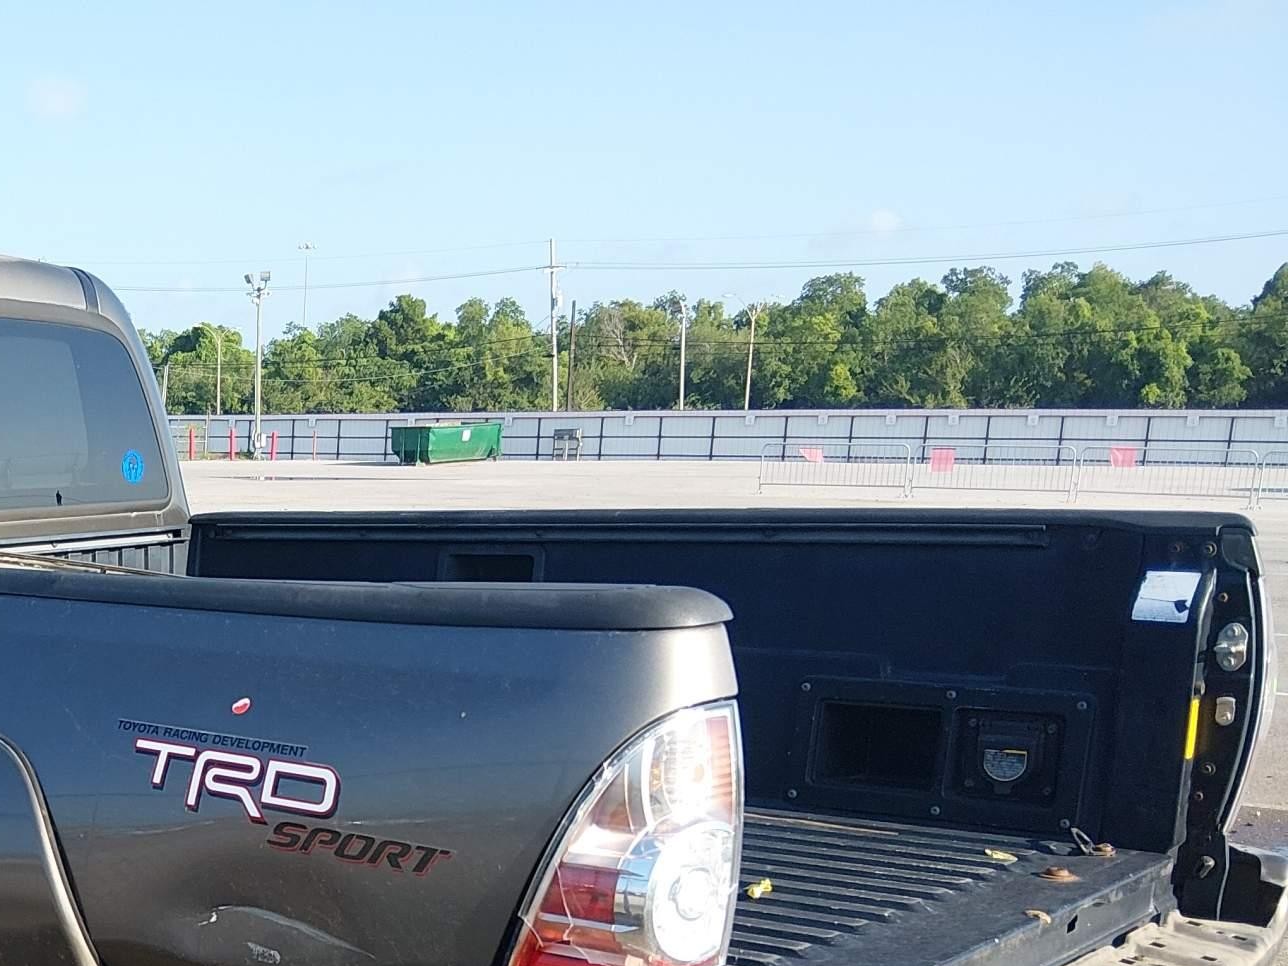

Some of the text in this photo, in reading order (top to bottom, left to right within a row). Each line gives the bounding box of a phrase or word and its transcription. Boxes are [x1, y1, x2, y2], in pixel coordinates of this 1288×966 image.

[117, 720, 307, 757] TOYOTA RACING DEVELOPMENT
[135, 738, 342, 824] TRD
[267, 821, 452, 877] SPORT
